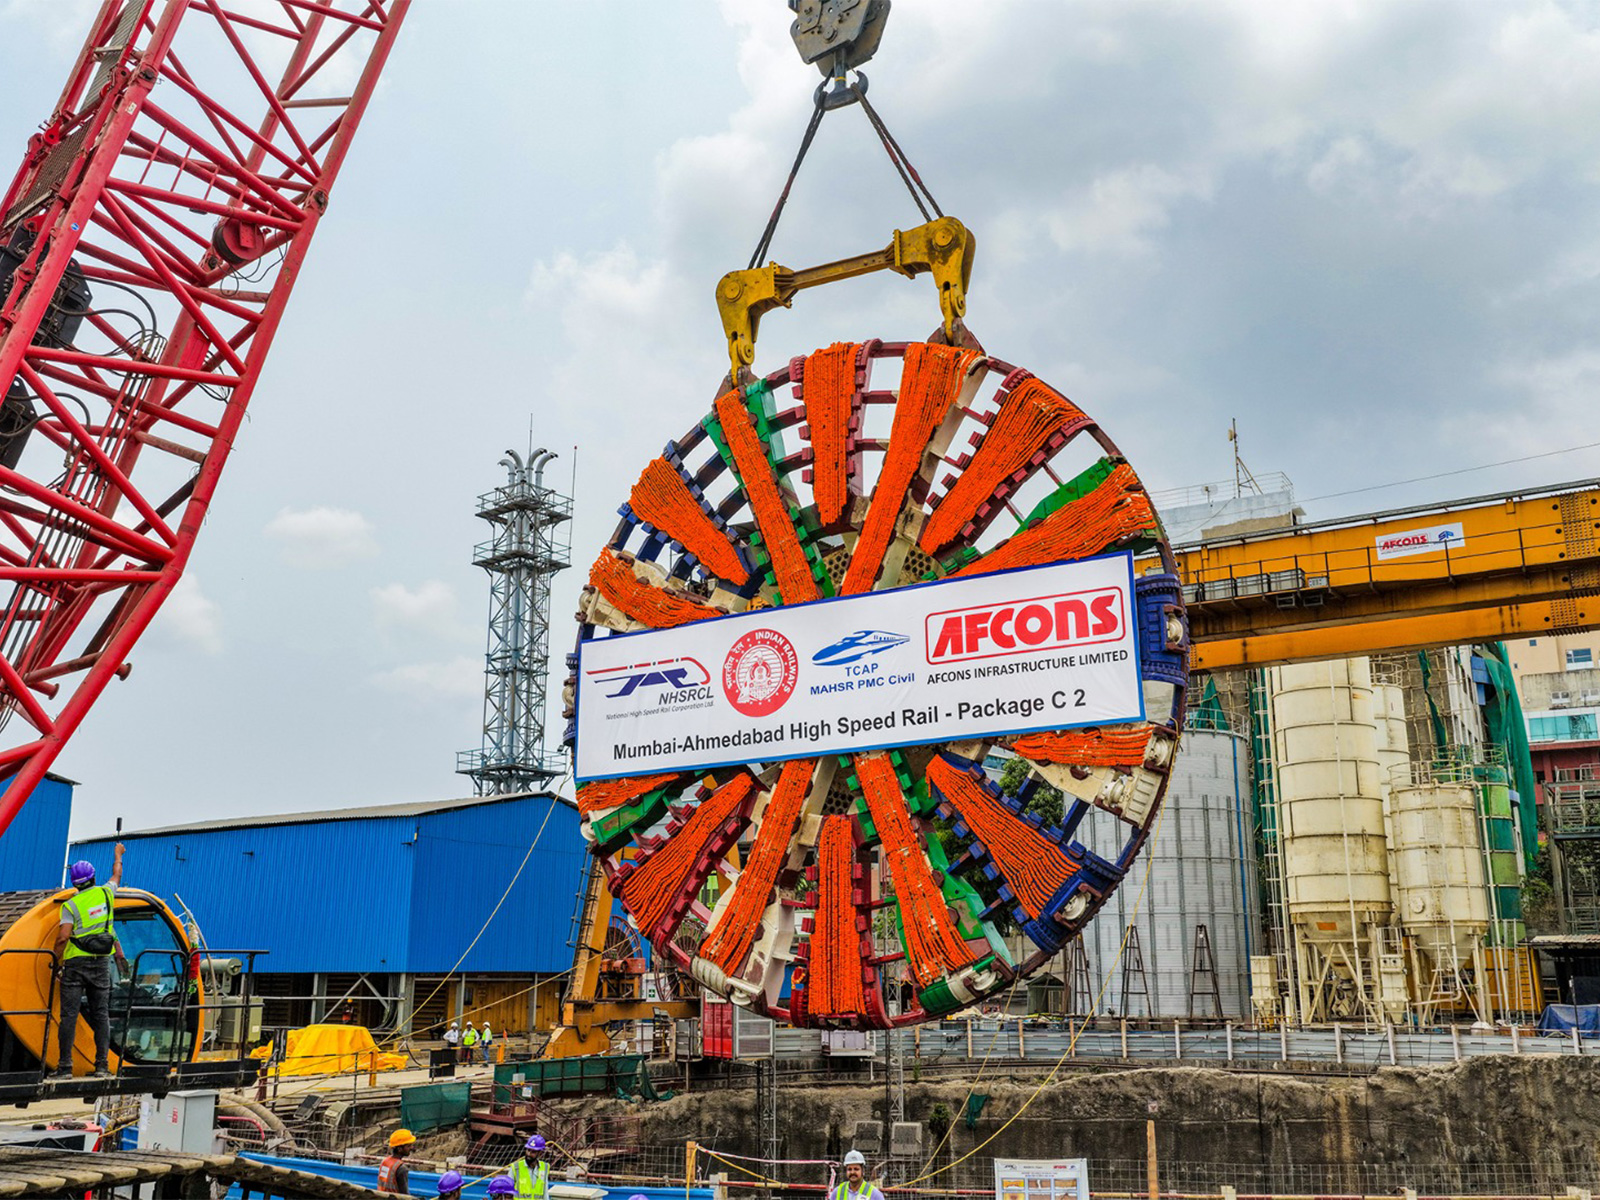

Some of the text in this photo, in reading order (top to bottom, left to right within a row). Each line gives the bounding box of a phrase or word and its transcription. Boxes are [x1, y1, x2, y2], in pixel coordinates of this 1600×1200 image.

[932, 594, 1119, 659] AFCONS
[755, 631, 797, 693] INDIAN RAILWAYS
[845, 663, 879, 677] TCAP
[927, 649, 1129, 685] AFCONS INFRASTRUCTURE LIMITED
[658, 686, 714, 706] NHSRCL
[810, 672, 915, 696] MAHSR PMC Civil
[606, 711, 629, 721] National
[630, 709, 643, 719] High
[643, 707, 660, 717] Speed
[660, 705, 671, 714] Rail
[671, 701, 703, 713] Corporation
[613, 725, 784, 760] Mumbai-Ahmedabad
[790, 720, 831, 742] High
[837, 711, 896, 737] Speed
[902, 705, 939, 727] Rail
[958, 696, 1045, 720] Package
[1051, 690, 1067, 709] C
[1073, 688, 1086, 707] 2
